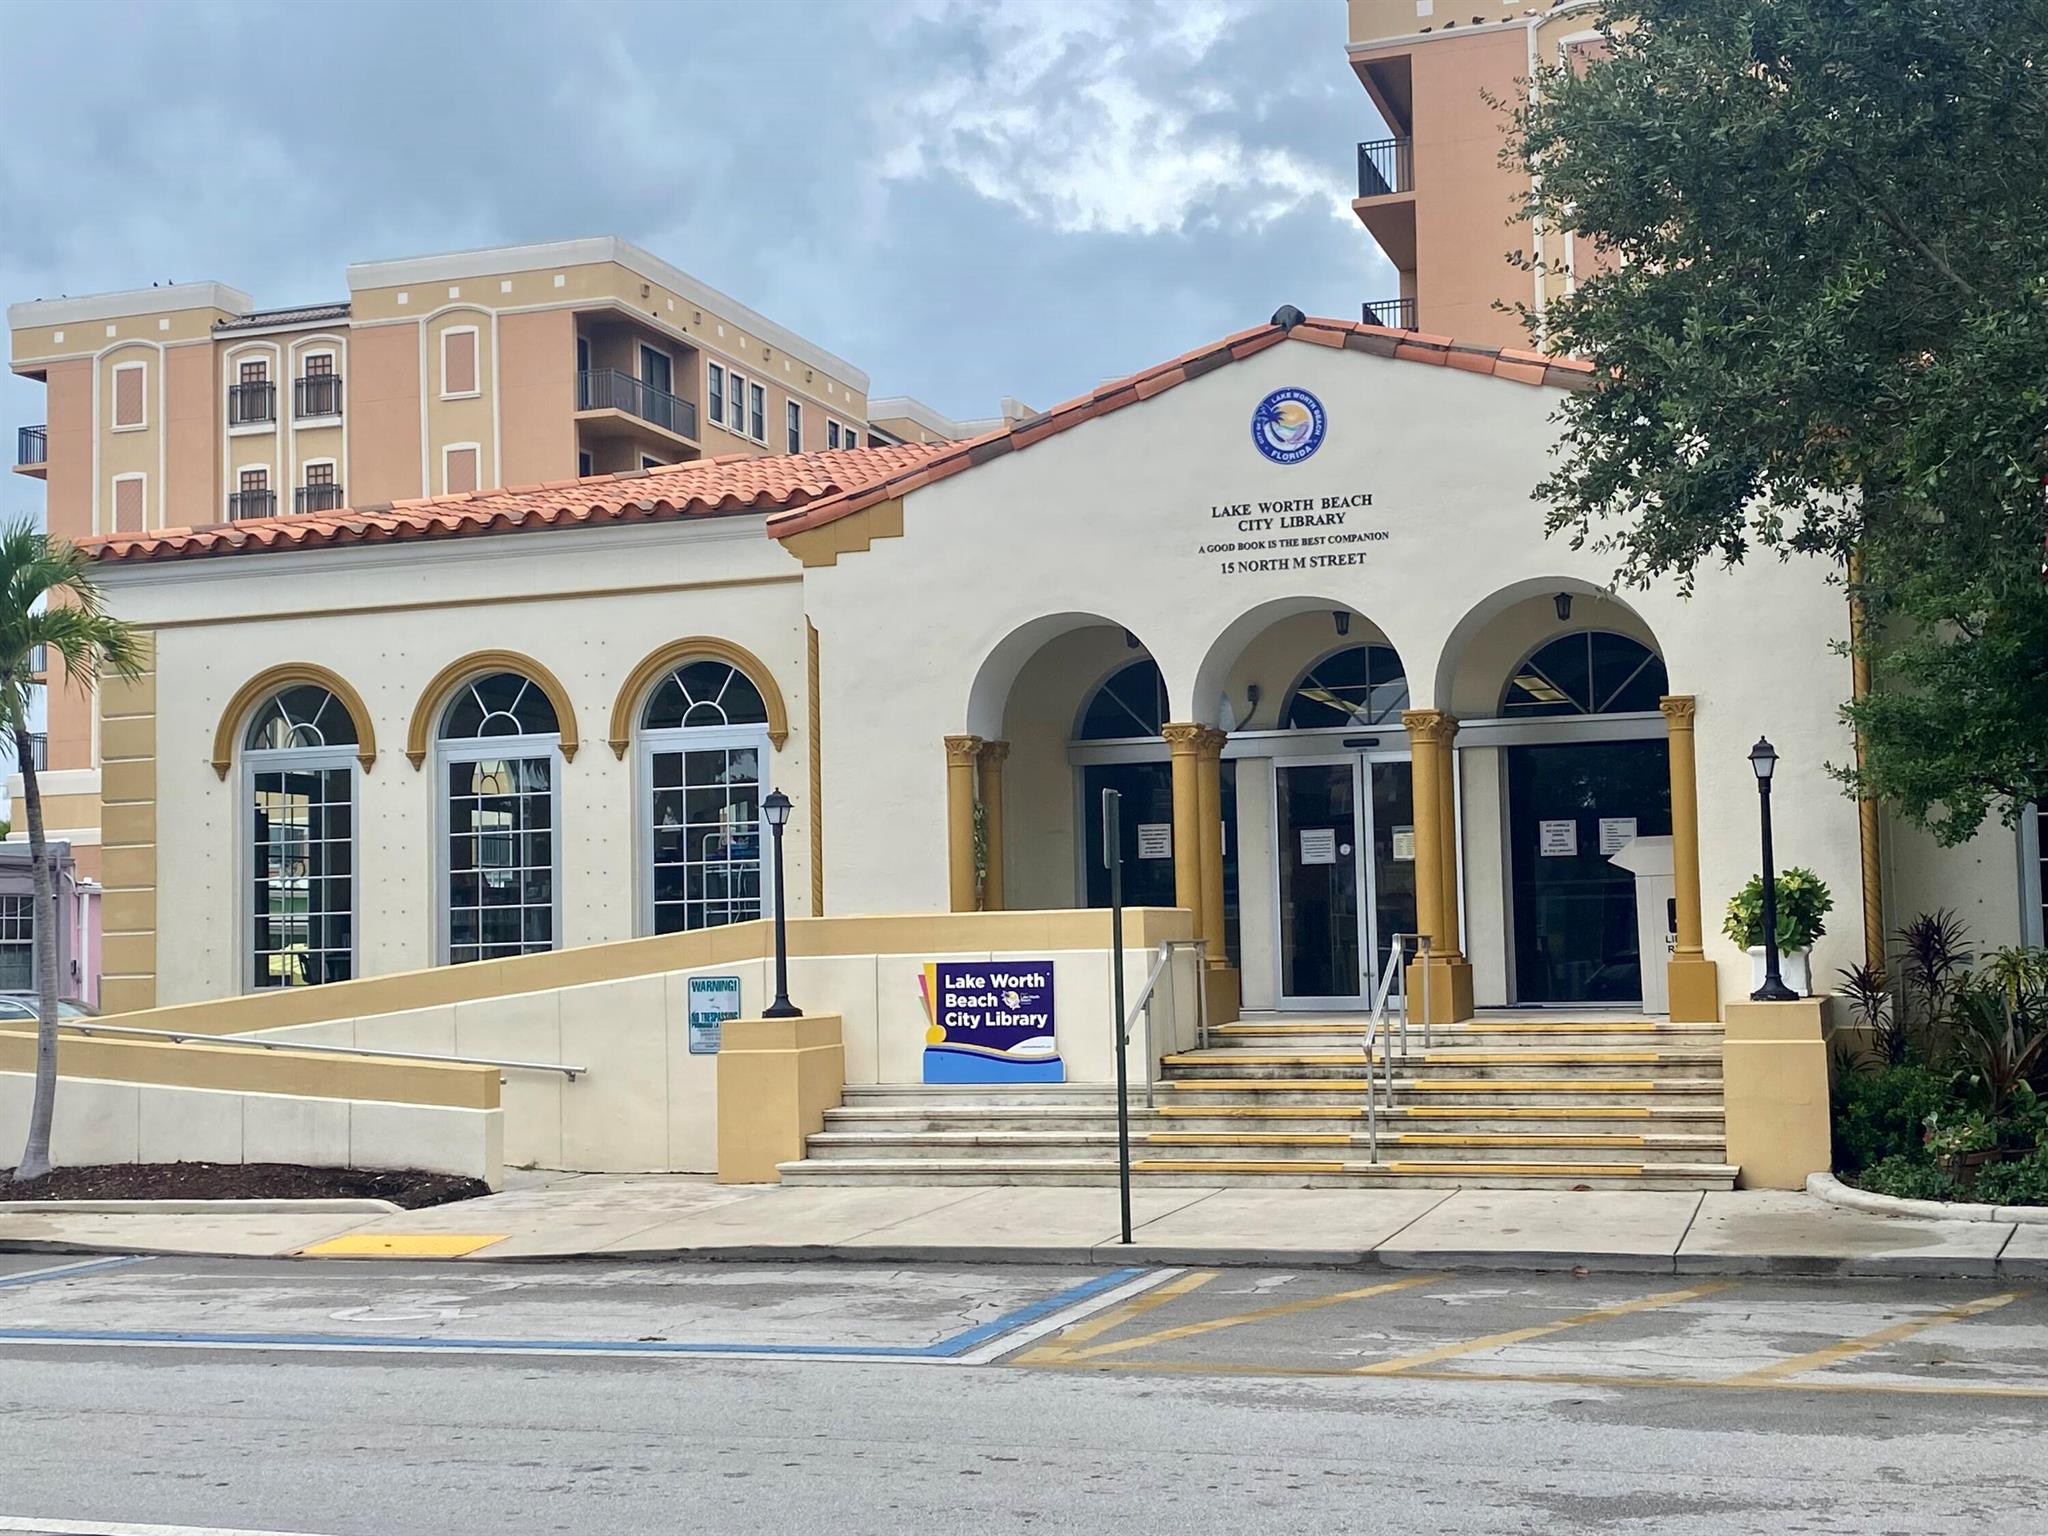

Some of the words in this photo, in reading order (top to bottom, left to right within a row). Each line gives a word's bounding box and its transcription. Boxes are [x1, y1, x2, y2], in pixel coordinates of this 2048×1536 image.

[1271, 392, 1292, 404] LAKE
[1293, 392, 1316, 410] WORTH
[1313, 407, 1322, 436] BEACH
[1271, 445, 1312, 461] FLORIDA
[1211, 504, 1251, 518] LAKE
[1258, 499, 1314, 513] WORTH
[1321, 494, 1373, 510] BEACH
[1238, 518, 1274, 532] CITY
[1280, 512, 1346, 528] LIBRARY
[1198, 546, 1206, 554] A
[1207, 543, 1235, 553] GOOD
[1237, 540, 1266, 551] BOOK
[1267, 540, 1277, 549] IS
[1279, 538, 1300, 548] THE
[1301, 536, 1326, 546] BEST
[1327, 531, 1390, 545] COMPANION
[1221, 562, 1235, 574] 15
[1238, 558, 1290, 573] NORTH
[1293, 557, 1306, 569] M
[1309, 552, 1367, 568] STREET
[691, 980, 737, 992] WARNING!
[944, 974, 986, 989] Lake
[990, 973, 1045, 988] Worth
[945, 992, 998, 1008] Beach
[944, 1012, 981, 1029] City
[985, 1011, 1048, 1029] Library
